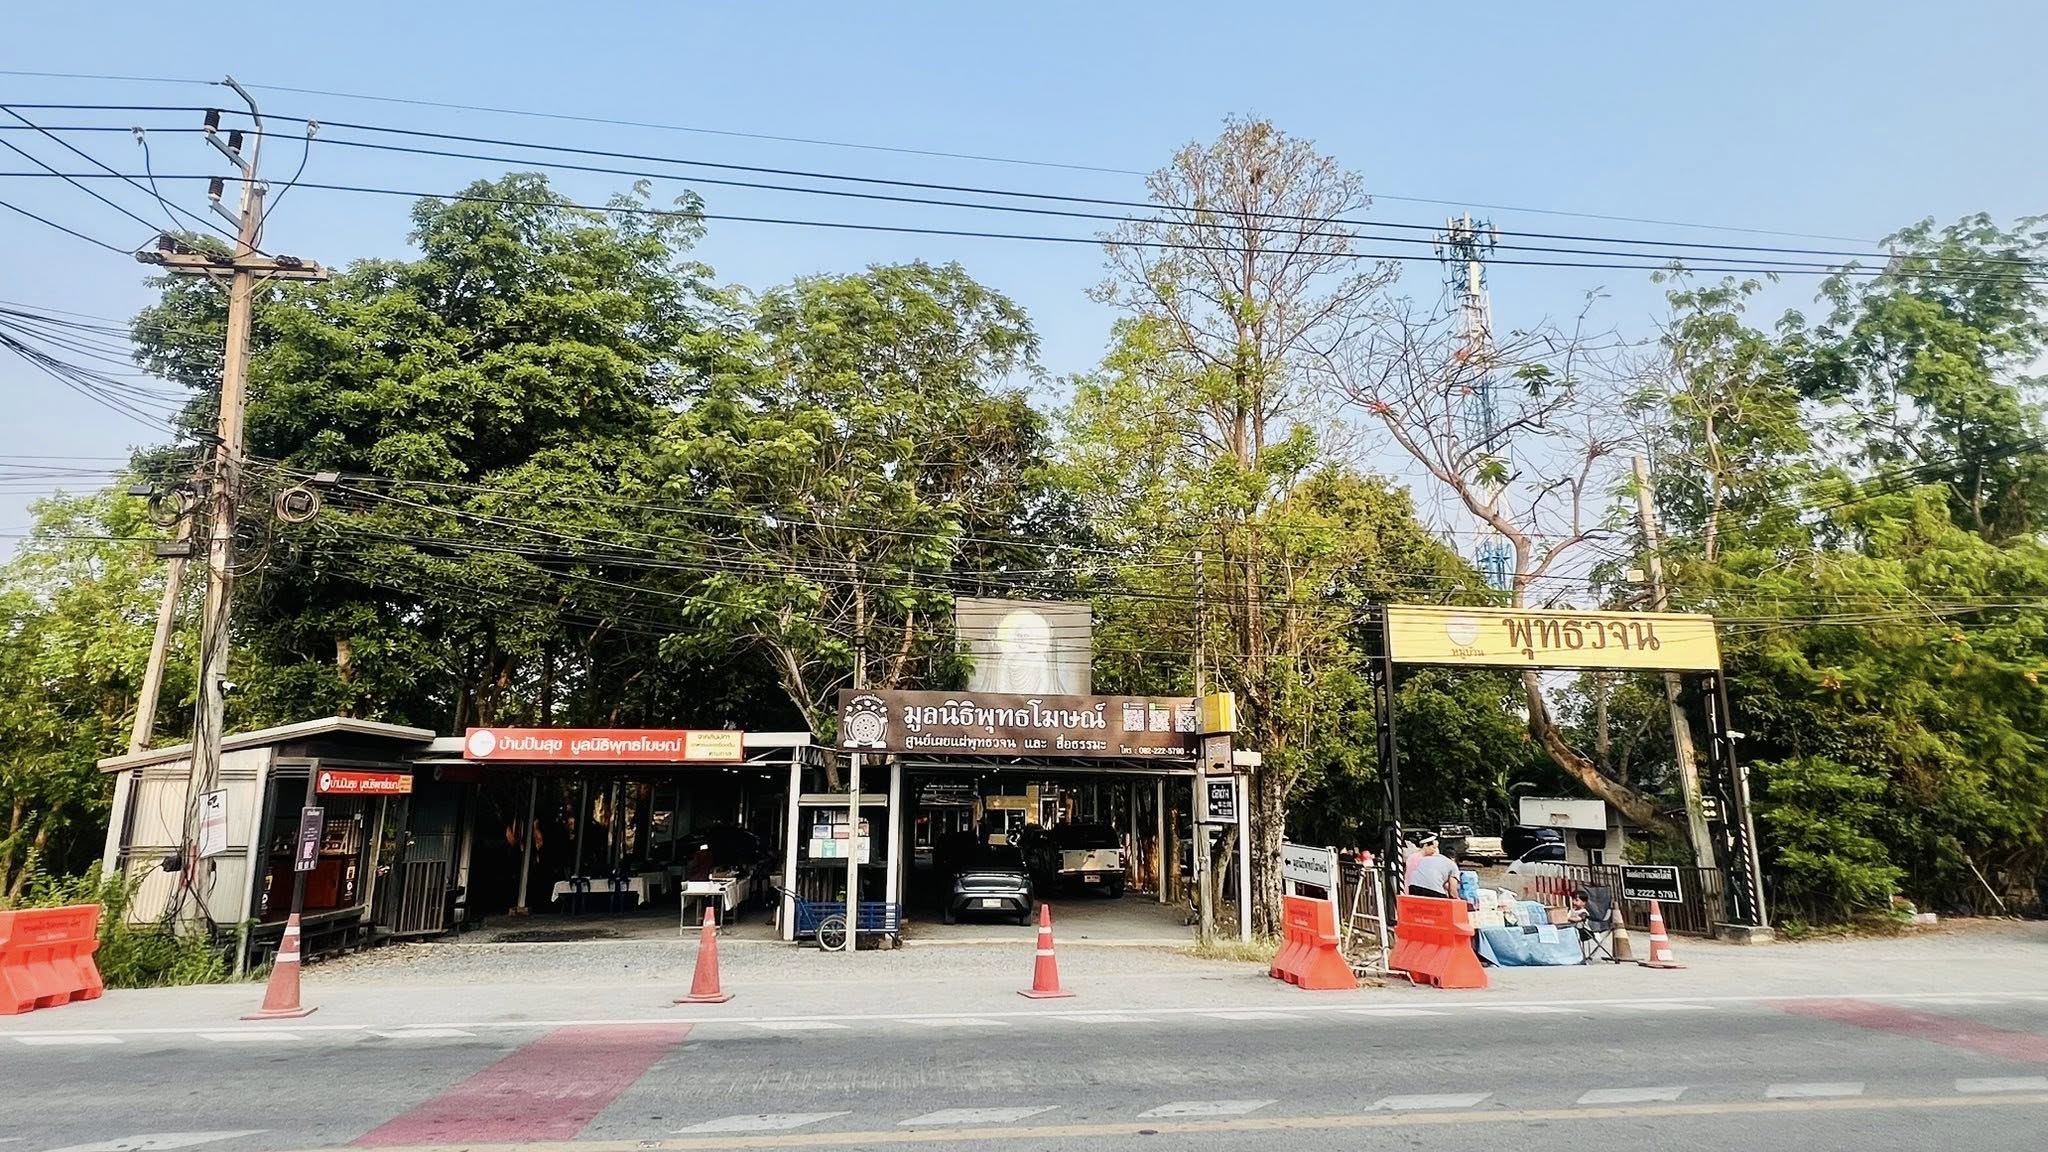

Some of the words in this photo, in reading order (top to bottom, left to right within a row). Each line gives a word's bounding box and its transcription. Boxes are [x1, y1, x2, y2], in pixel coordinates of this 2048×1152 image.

[1502, 617, 1660, 660] พุทธวจน
[903, 698, 1107, 734] มูลนิธิพุทธโฆษณ์
[1024, 739, 1048, 750] และ
[1056, 733, 1107, 750] สื่อธรรมะ
[1637, 889, 1656, 897] 2222
